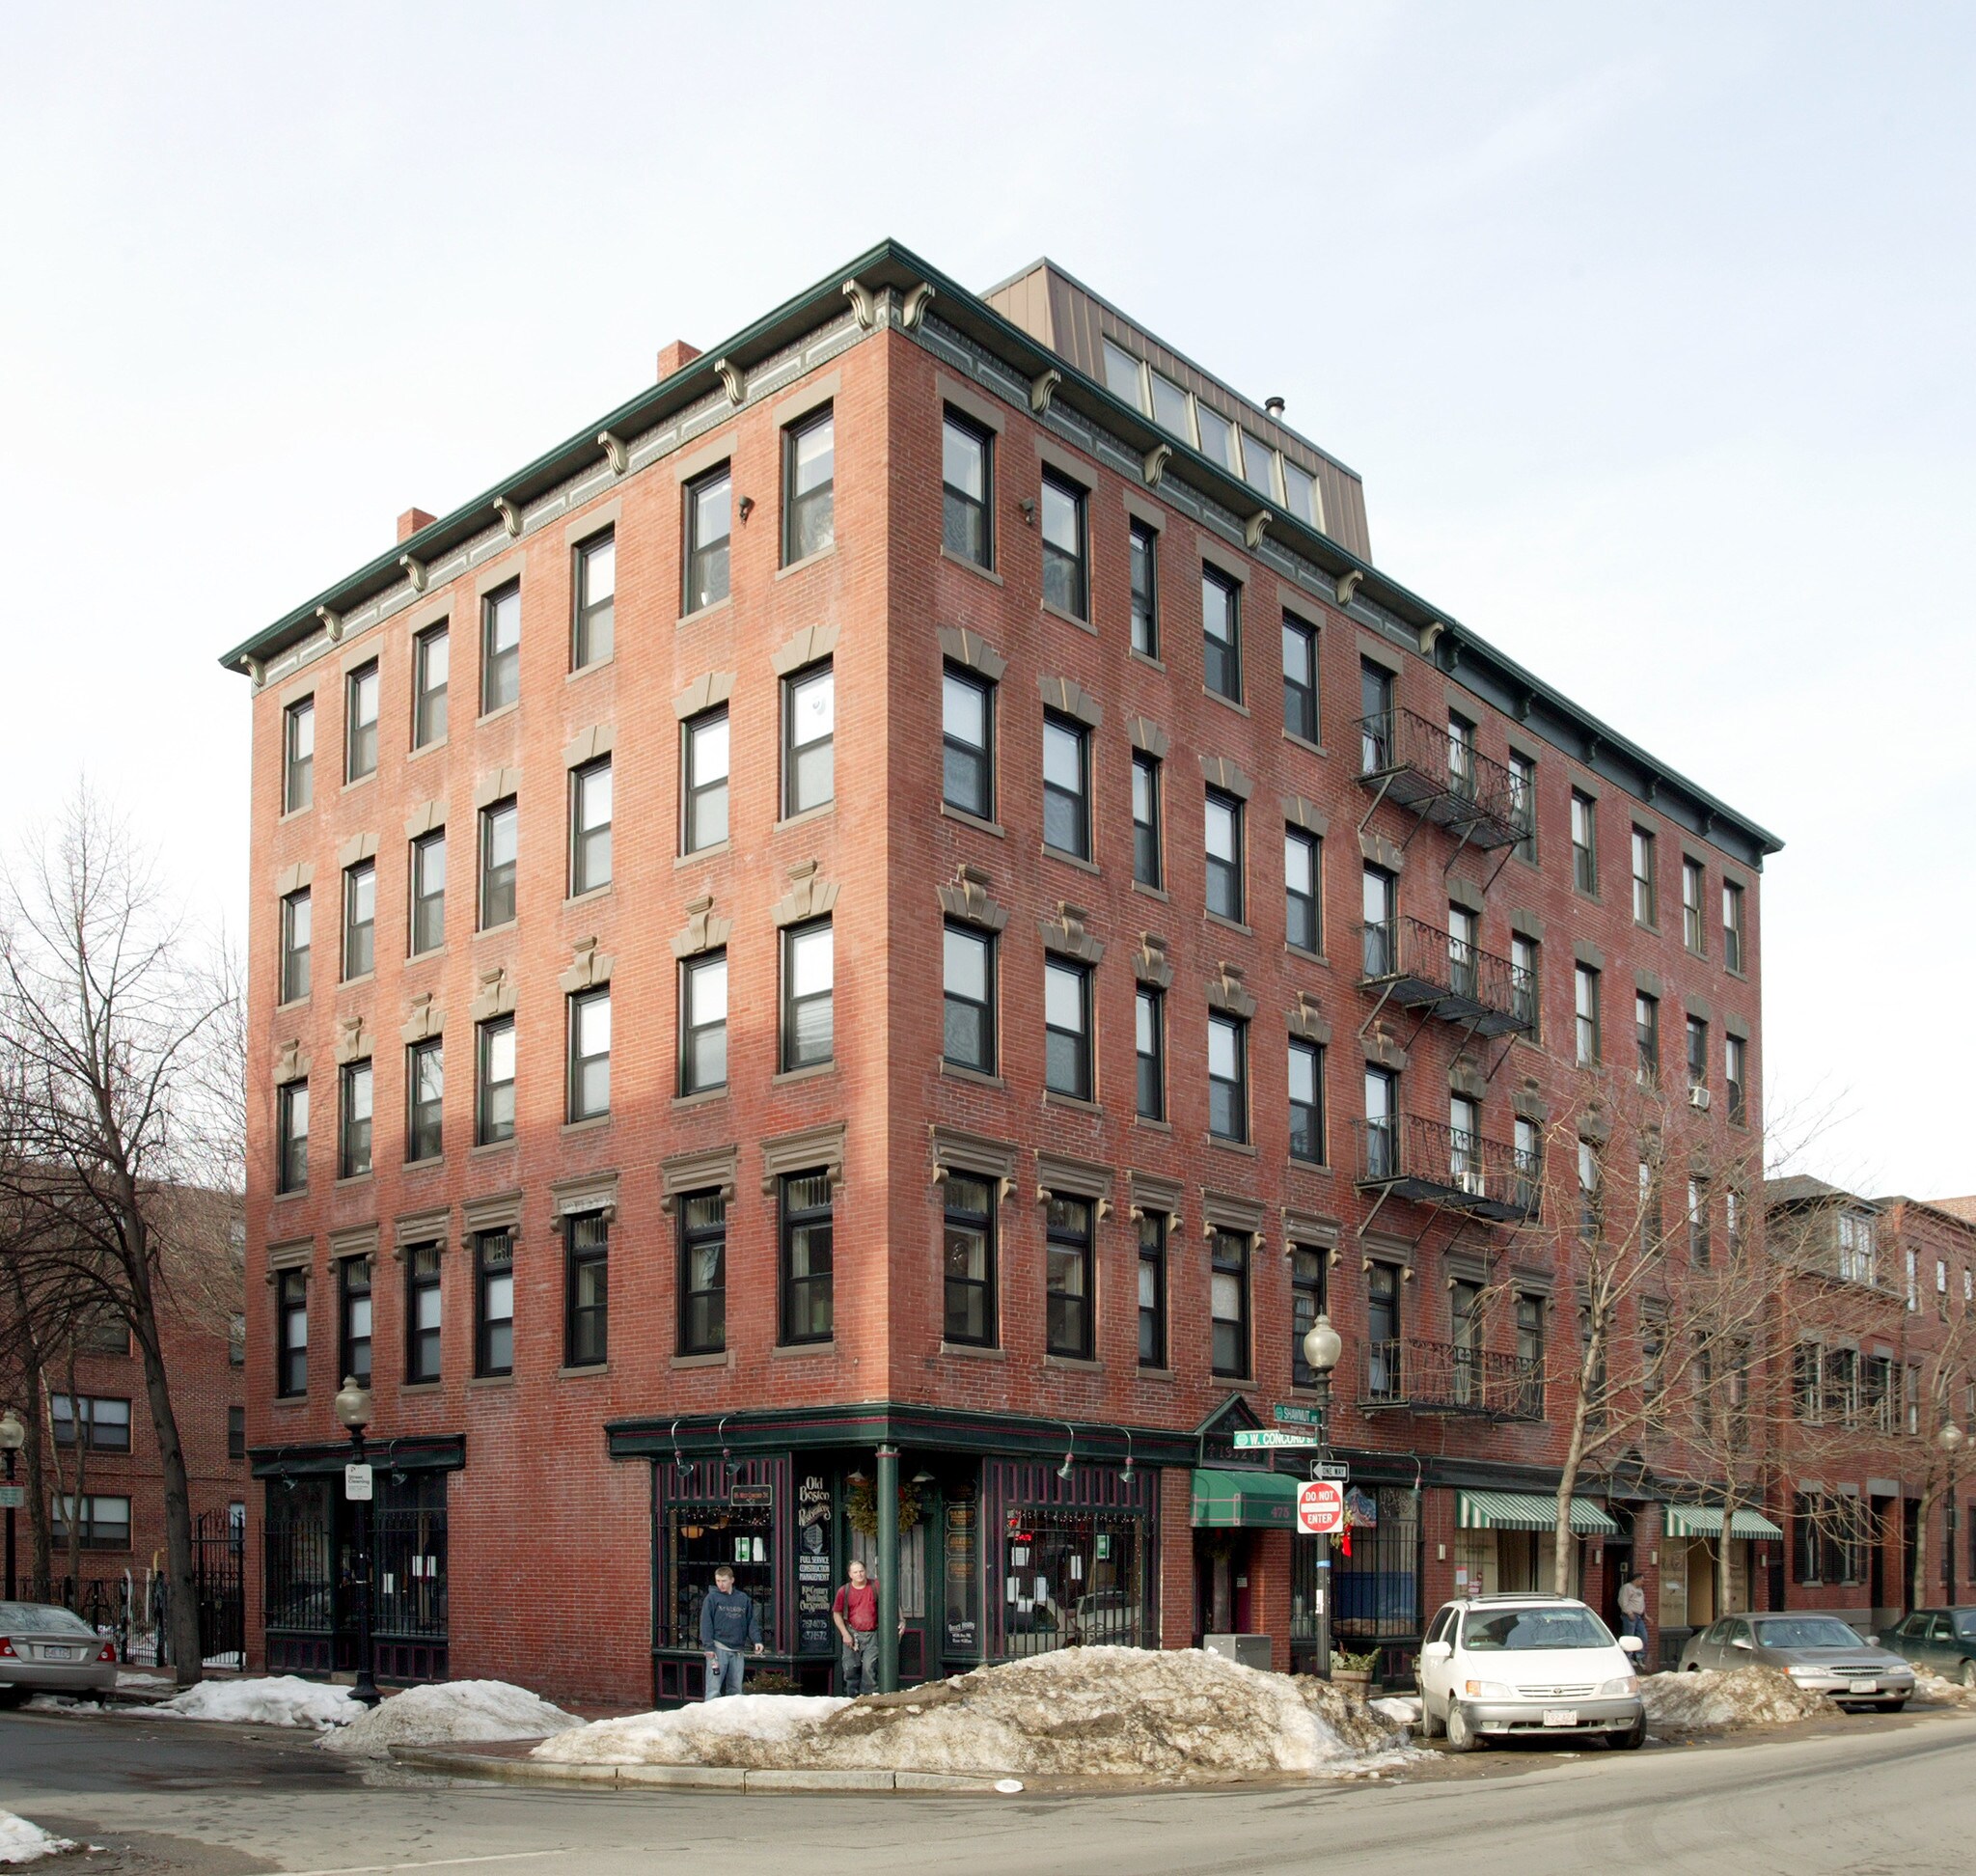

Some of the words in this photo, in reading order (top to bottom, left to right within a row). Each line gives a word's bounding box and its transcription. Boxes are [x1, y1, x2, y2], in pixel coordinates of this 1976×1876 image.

[1283, 1407, 1310, 1422] SHAWMUT
[1249, 1434, 1260, 1445] W.
[1262, 1433, 1304, 1445] CONCORD
[806, 1476, 823, 1491] Old
[799, 1485, 830, 1503] Boston
[1305, 1492, 1316, 1501] DO
[1319, 1491, 1333, 1501] NOT
[1272, 1506, 1290, 1518] 475
[1307, 1513, 1332, 1524] ENTER
[811, 1556, 829, 1564] SERVICE
[800, 1564, 830, 1573] CONSTRUCTION
